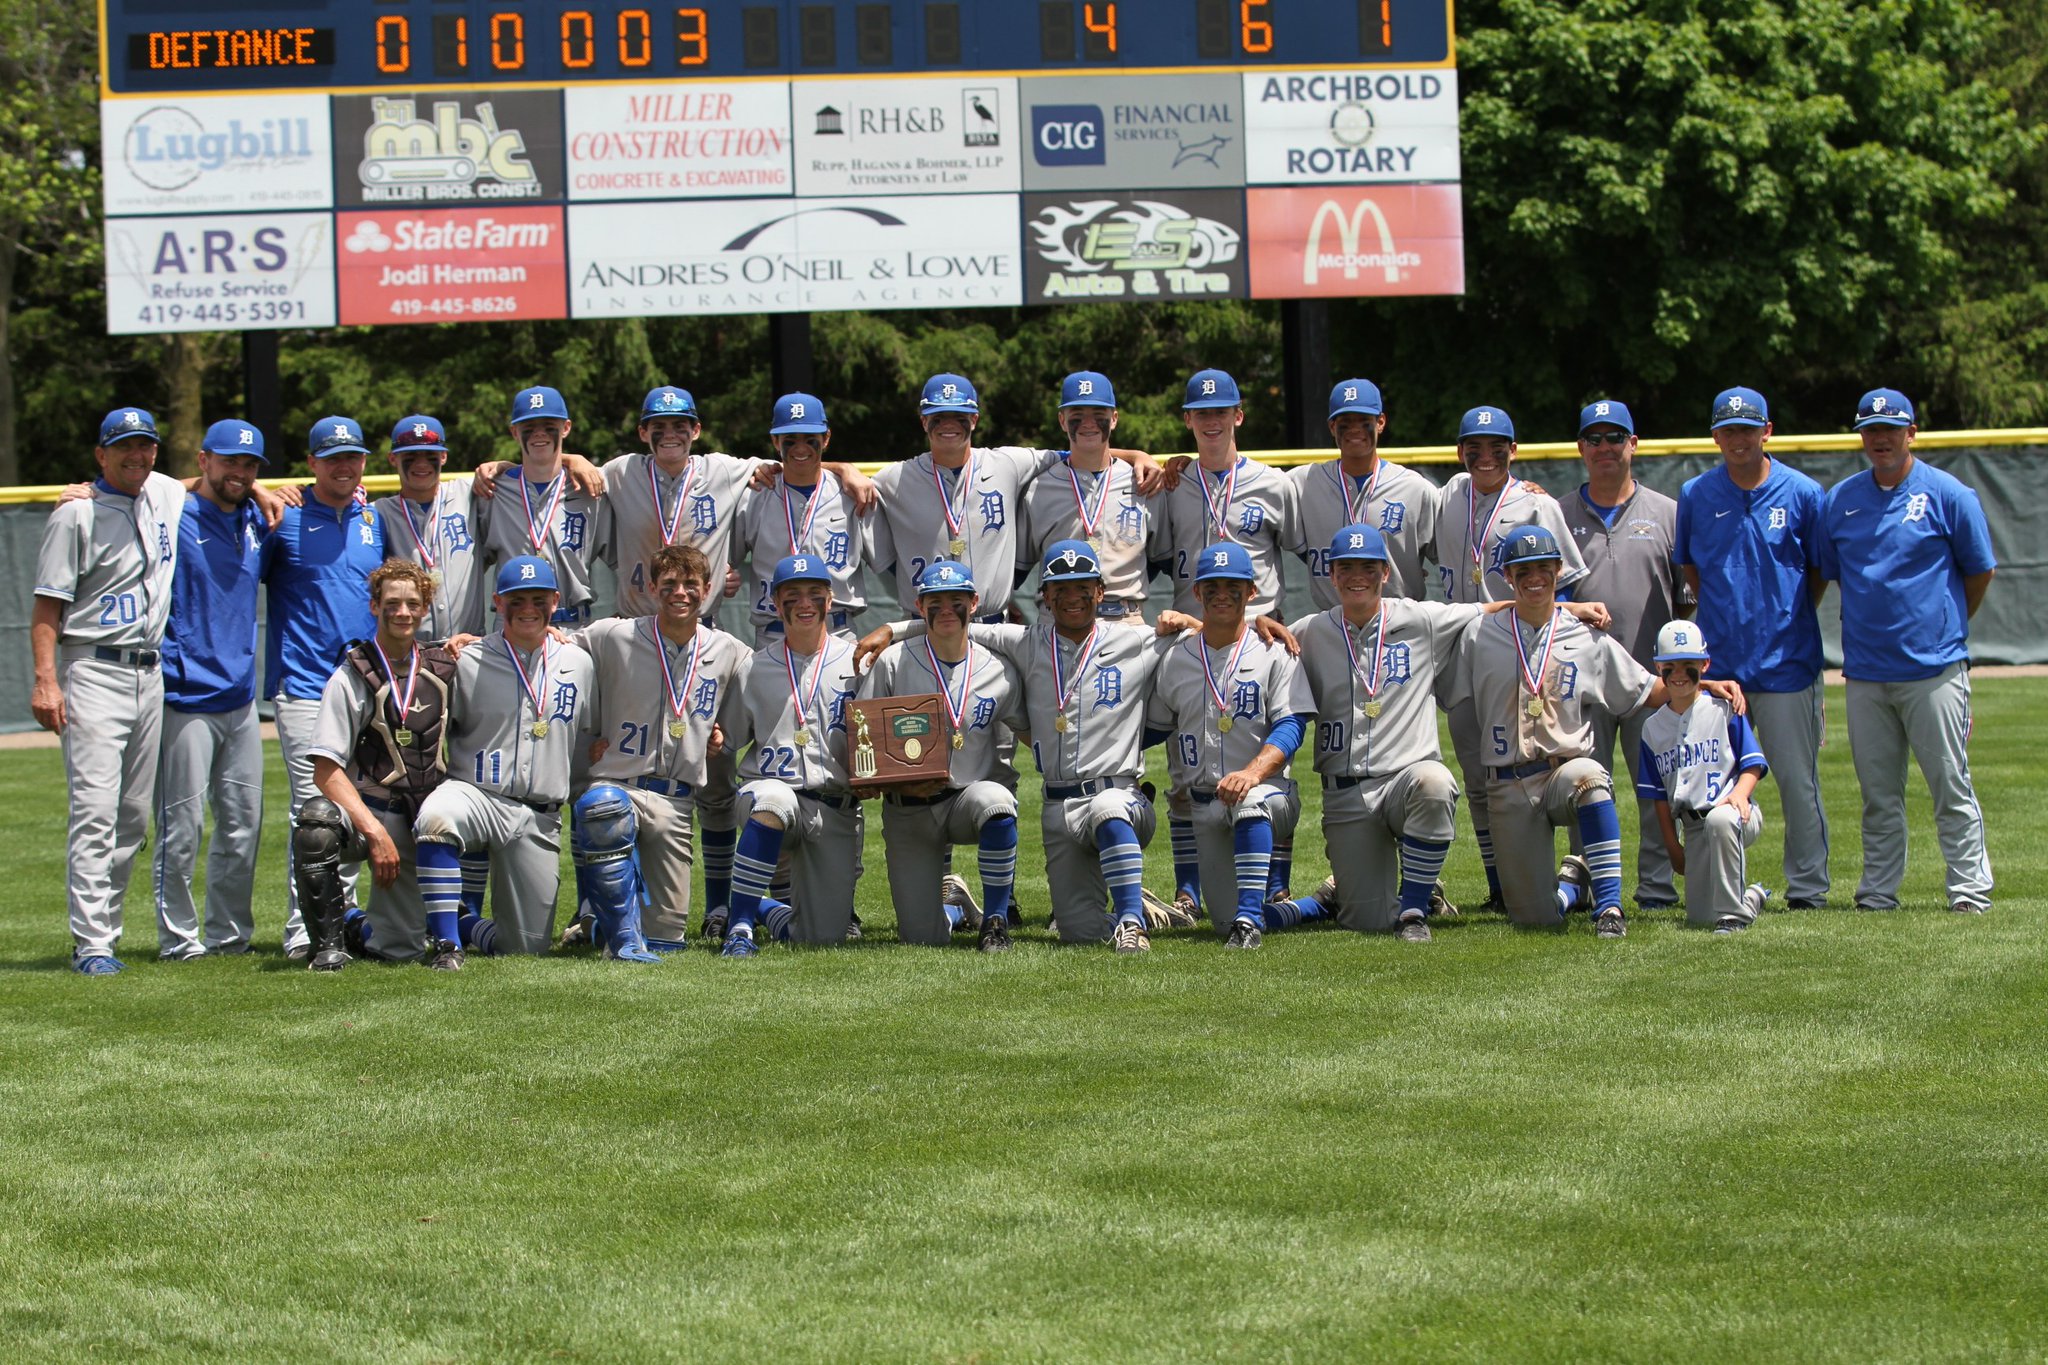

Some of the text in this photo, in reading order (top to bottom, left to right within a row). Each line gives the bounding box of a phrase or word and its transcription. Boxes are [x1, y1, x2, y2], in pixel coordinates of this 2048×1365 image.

[149, 0, 1391, 73] DEFIANCE 0 1 0 0 0 3 4 6 1
[1261, 75, 1442, 103] ARCHBOLD
[626, 93, 733, 122] MILLER
[859, 107, 945, 135] RH&B
[1113, 103, 1233, 126] FINANCIAL
[134, 118, 312, 171] Lugbill
[571, 128, 786, 161] CONSTRUCTION
[1040, 120, 1097, 151] CIG
[1114, 128, 1180, 142] SERVICES
[976, 156, 1004, 169] LLP
[1287, 146, 1418, 175] ROTARY
[362, 185, 424, 201] MILLER
[427, 184, 476, 199] BROS.
[575, 168, 786, 190] CONCRETE & EXCAVATING
[581, 251, 1009, 289] ANDRES O'NEIL & LOWE
[1317, 252, 1421, 269] McDonald's
[152, 280, 288, 299] Refuse Service
[379, 264, 526, 287] Jodi Herman
[1043, 269, 1230, 297] Auto & Tire
[390, 296, 516, 315] 419-445-8626
[586, 286, 1005, 311] INSURANCE AGENCY
[99, 593, 137, 627] 20
[619, 721, 649, 756] 21
[1178, 733, 1198, 768] 13
[1320, 721, 1345, 752] 30
[1492, 725, 1508, 756] 5
[474, 748, 502, 784] 11
[760, 746, 796, 777] 22
[1707, 772, 1721, 802] 5
